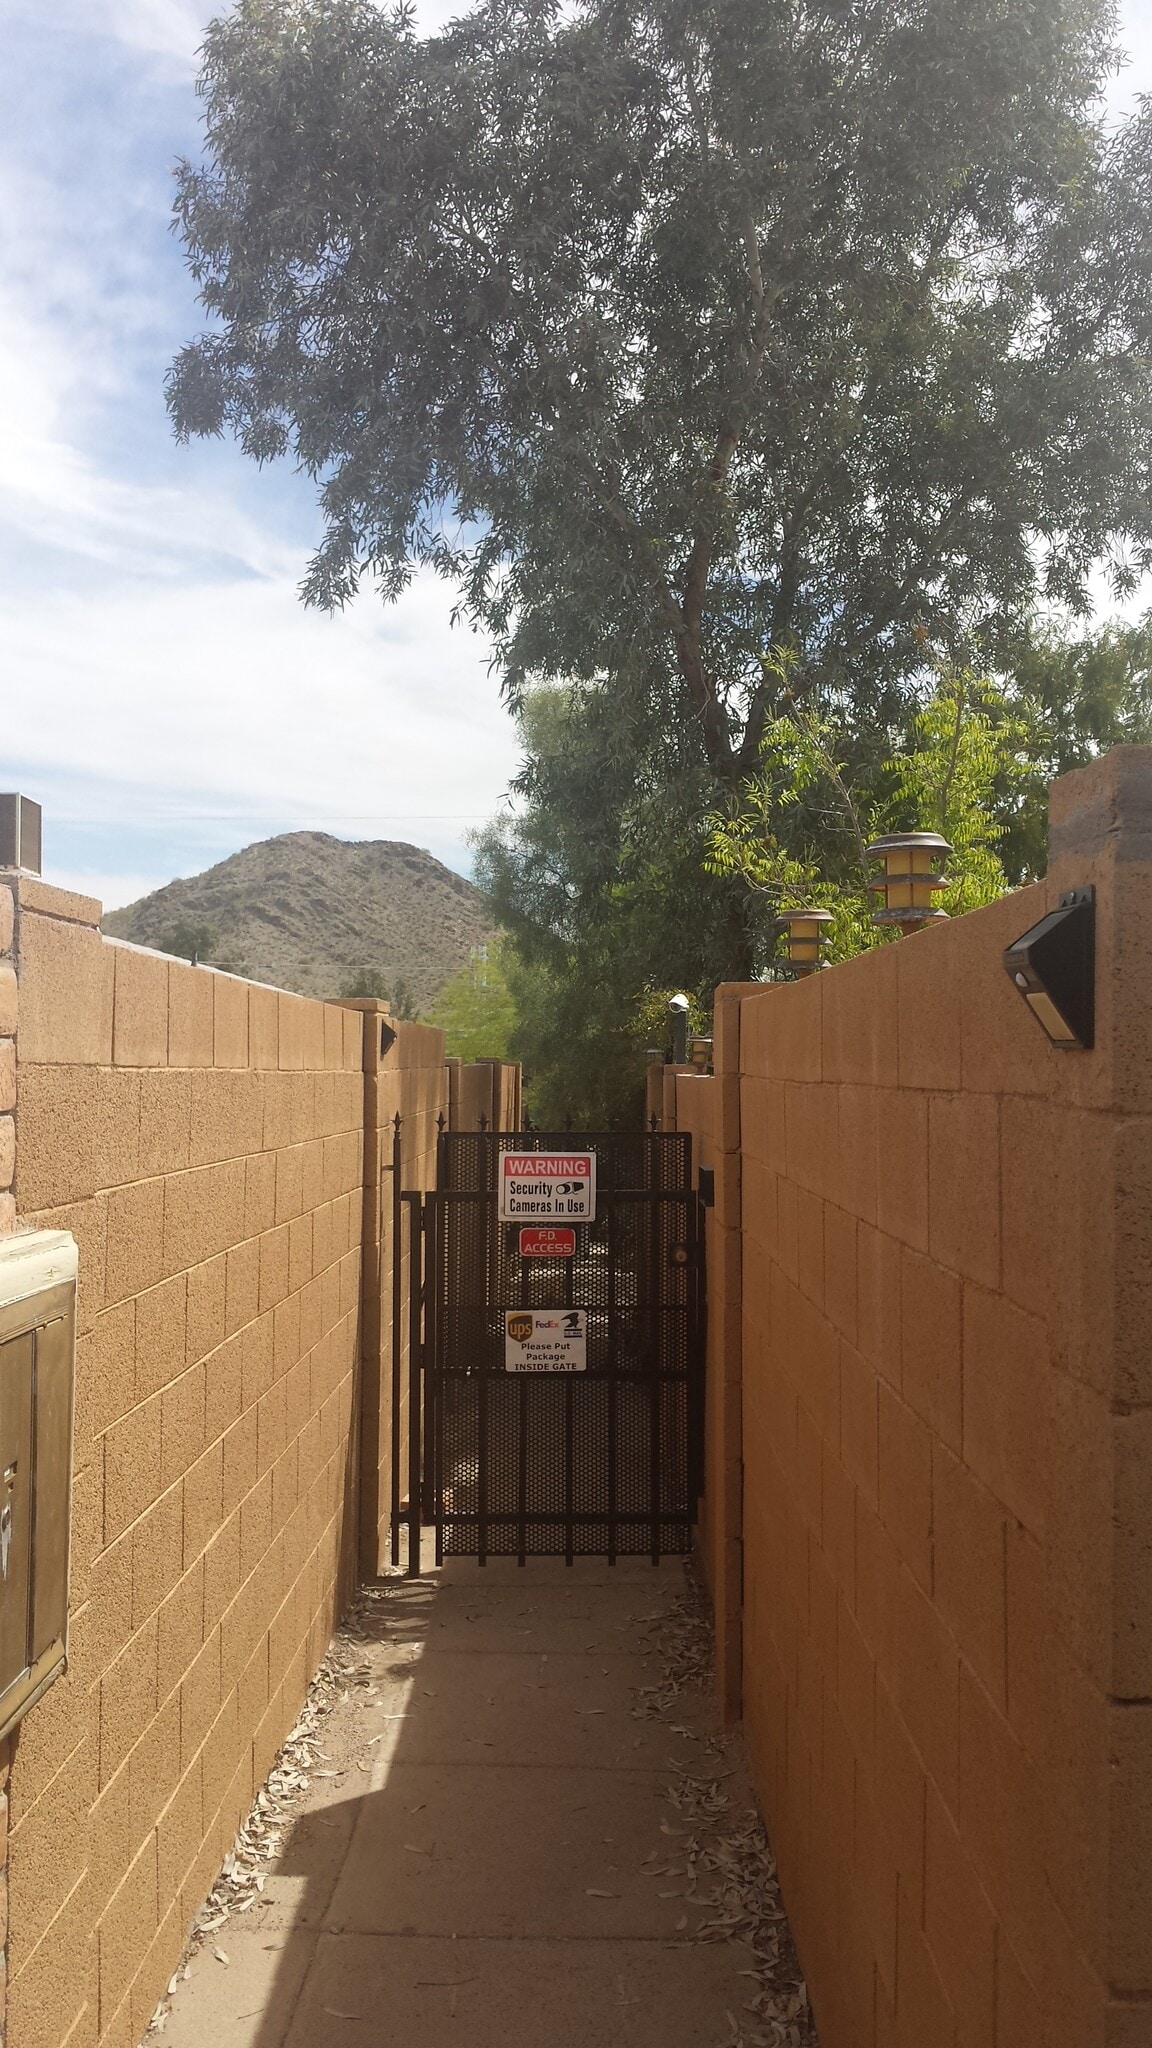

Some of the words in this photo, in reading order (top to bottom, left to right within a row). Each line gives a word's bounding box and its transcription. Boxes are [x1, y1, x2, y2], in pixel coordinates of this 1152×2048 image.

[509, 1160, 586, 1174] WARNING
[510, 1181, 552, 1197] Security
[510, 1198, 552, 1212] Cameras
[555, 1199, 564, 1212] In
[567, 1199, 584, 1212] Use
[538, 1231, 557, 1240] F.D.
[524, 1243, 572, 1253] ACCESS
[510, 1324, 531, 1339] ups
[526, 1353, 566, 1361] Package
